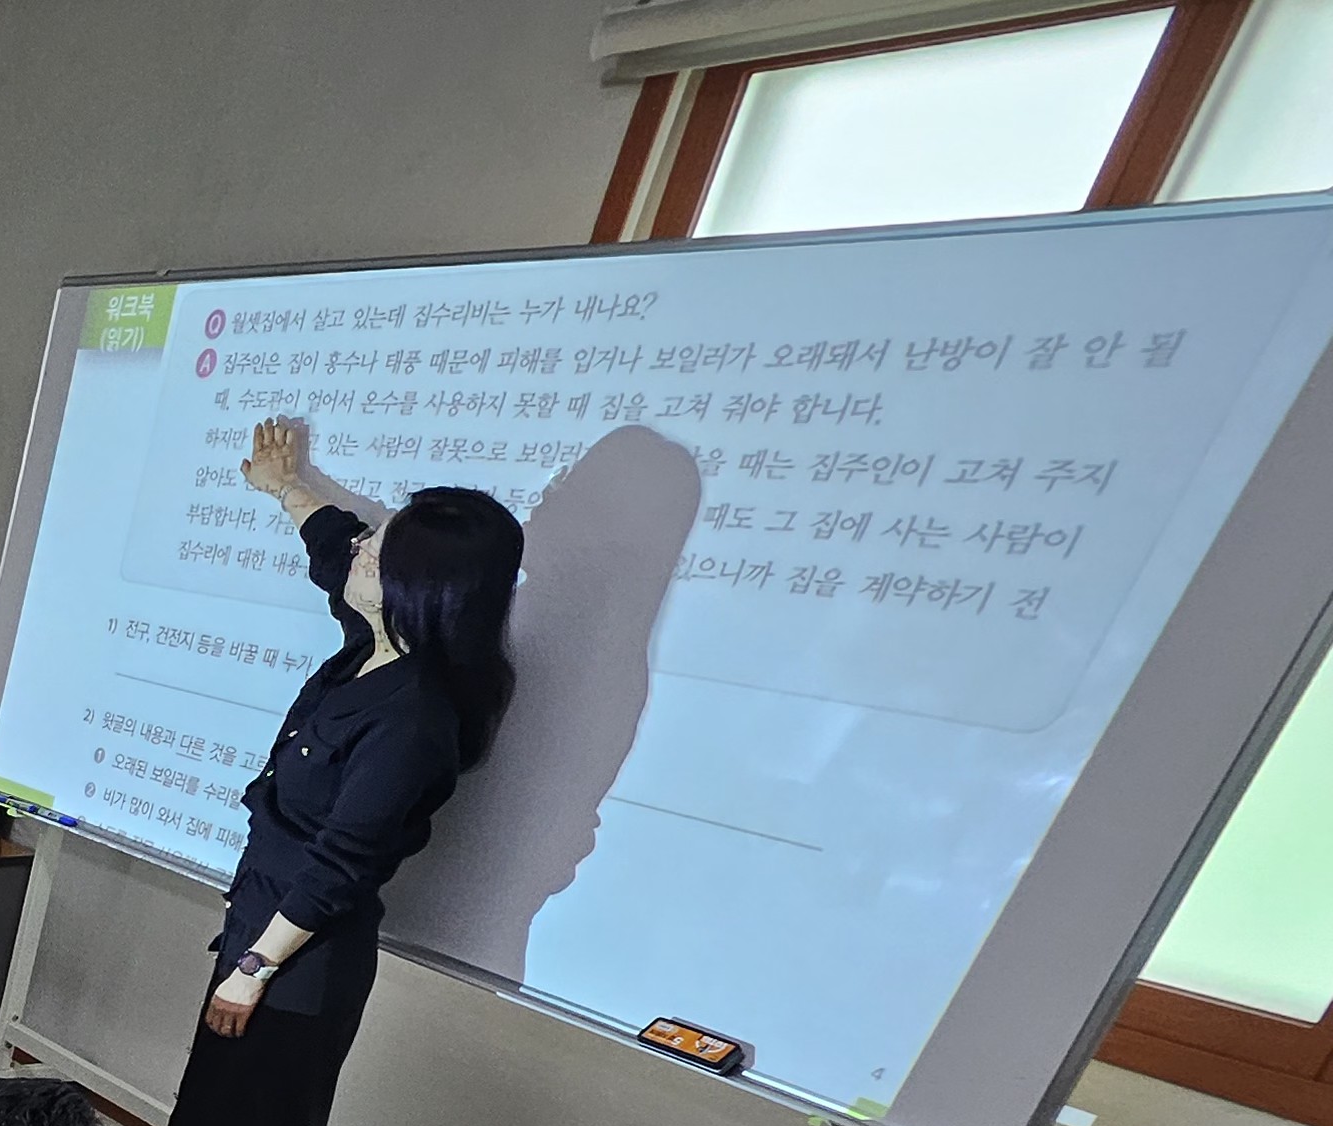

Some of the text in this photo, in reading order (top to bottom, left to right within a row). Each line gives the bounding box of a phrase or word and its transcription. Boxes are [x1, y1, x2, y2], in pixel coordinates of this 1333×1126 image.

[104, 292, 155, 319] 워크북
[232, 308, 307, 335] 월셋집에서
[312, 307, 346, 332] 살고
[352, 303, 407, 331] 있는데
[413, 299, 512, 328] 집수리비는
[519, 295, 566, 325] 누가
[574, 291, 659, 324] 내나요?
[99, 326, 145, 353] (읽기)
[222, 351, 282, 375] 집주인은
[287, 350, 320, 375] 집이
[324, 349, 379, 376] 홍수나
[385, 349, 423, 376] 태풍
[429, 347, 492, 375] 때문에
[496, 346, 563, 375] 피해를
[573, 344, 644, 375] 입거나
[648, 341, 757, 375] 보일러가
[763, 338, 893, 374] 오래돼서
[904, 333, 1015, 373] 난방이
[1024, 331, 1069, 372] 잘
[1082, 329, 1126, 370] 안
[1140, 326, 1188, 369] 될
[237, 387, 300, 414] 수도관이
[307, 389, 355, 416] 얼어서
[360, 389, 418, 416] 온수를
[424, 390, 508, 419] 사용하지
[513, 391, 560, 420] 못할
[567, 392, 587, 421] 때
[600, 391, 648, 423] 집을
[654, 391, 714, 421] 고쳐
[721, 392, 781, 424] 줘야
[791, 391, 883, 426] 합니다.
[204, 426, 249, 450] 하지만
[326, 431, 359, 457] 있는
[365, 433, 423, 460] 사람의
[429, 436, 508, 464] 잘못으로
[516, 440, 589, 468] 보일러
[739, 448, 795, 481] 때는
[807, 451, 936, 487] 집주인이
[943, 456, 1024, 492] 고쳐
[1035, 459, 1119, 496] 주지
[177, 540, 233, 566] 집수리에
[236, 548, 267, 572] 대한
[703, 502, 758, 529] 때도
[764, 508, 796, 533] 그
[809, 509, 873, 543] 집에
[880, 515, 951, 549] 사는
[963, 520, 1085, 560] 사람이
[185, 502, 257, 532] 부담합니다.
[786, 563, 846, 599] 집을
[857, 572, 996, 615] 계약하기
[1011, 585, 1052, 621] 전
[107, 617, 119, 635] 1)
[155, 624, 196, 651] 건전지
[197, 633, 226, 658] 등을
[228, 639, 256, 665] 바꿀
[262, 647, 279, 669] 때
[83, 707, 94, 725] 2)
[102, 710, 138, 738] 윗글의
[139, 720, 177, 749] 내용과
[179, 733, 207, 758] 다른
[209, 742, 238, 769] 것을
[111, 753, 148, 780] 오래된
[149, 761, 202, 797] 보일러를
[202, 780, 243, 812] 수리할
[103, 788, 128, 809] 비가
[129, 794, 155, 821] 많이
[155, 805, 183, 830] 와서
[185, 815, 213, 842] 집에
[215, 827, 247, 853] 피해
